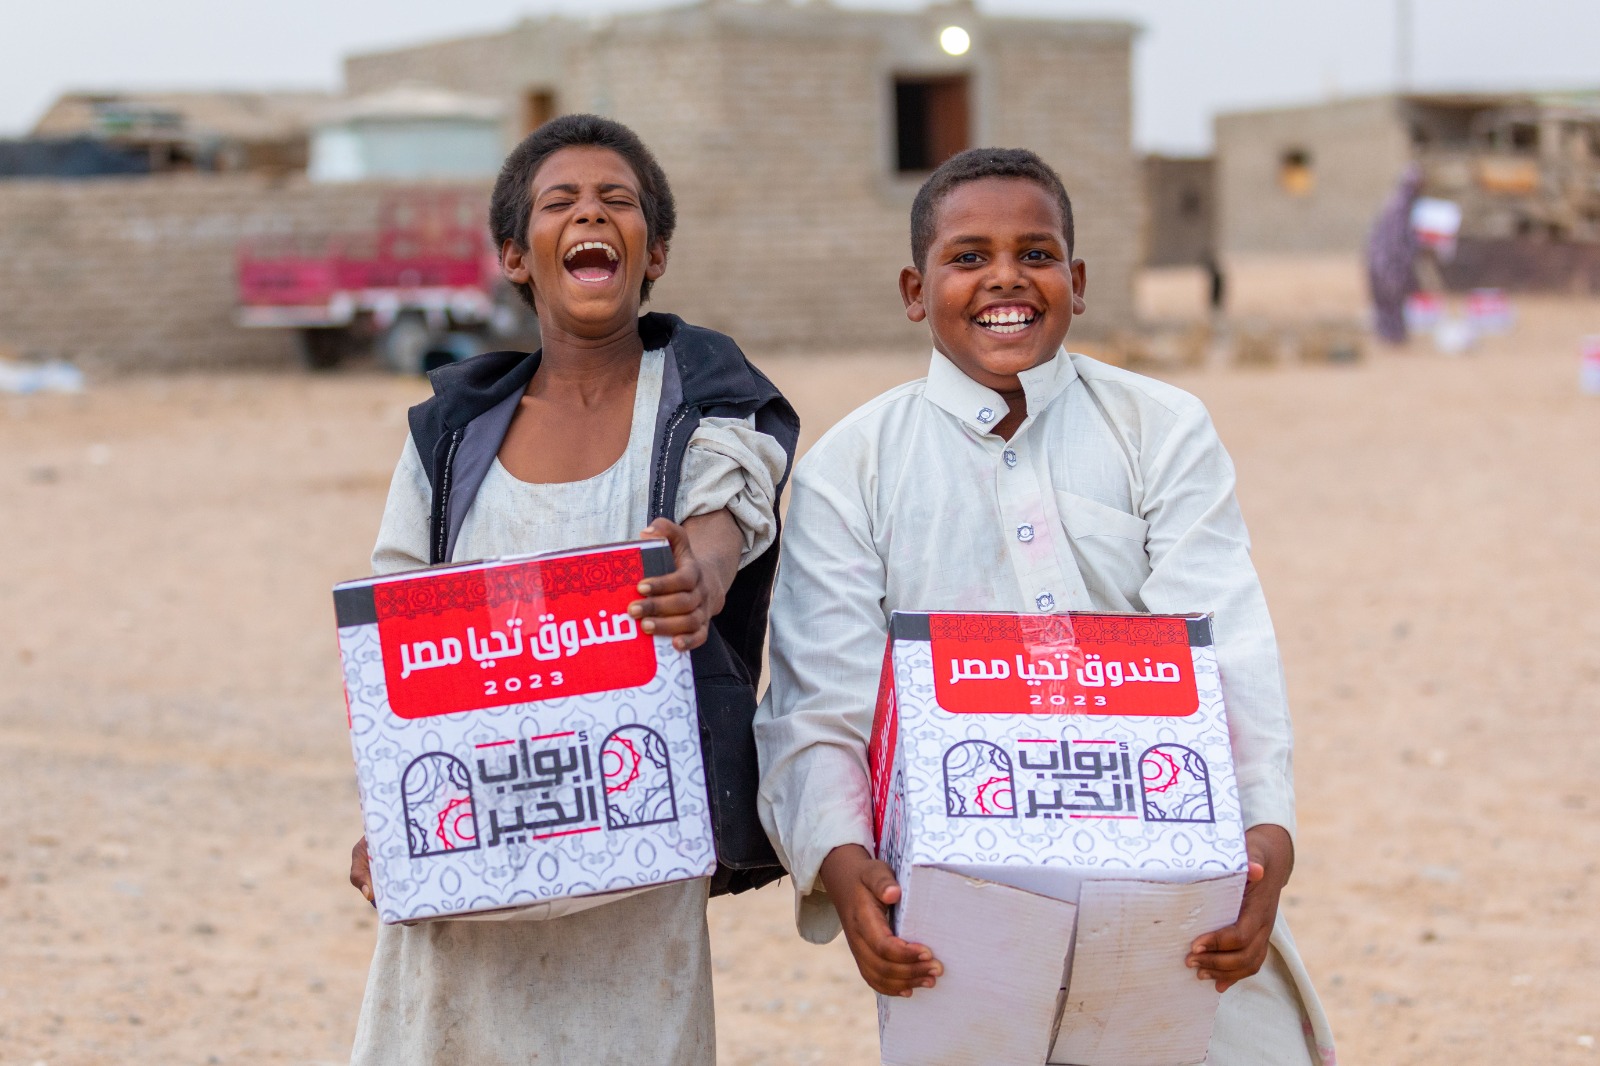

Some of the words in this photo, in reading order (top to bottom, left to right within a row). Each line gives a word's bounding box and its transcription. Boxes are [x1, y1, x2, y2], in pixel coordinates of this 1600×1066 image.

[467, 617, 524, 670] تحيا
[529, 609, 638, 662] صندوق
[399, 636, 463, 680] مصر
[949, 657, 1011, 685] مصر
[1015, 652, 1069, 687] تحيا
[1076, 653, 1181, 688] صندوق
[484, 670, 564, 696] 2023
[1029, 693, 1107, 706] 2023
[476, 730, 593, 795] أبواب
[1018, 740, 1132, 781] أبواب
[487, 785, 599, 848] الخير
[1024, 783, 1137, 819] الخير
